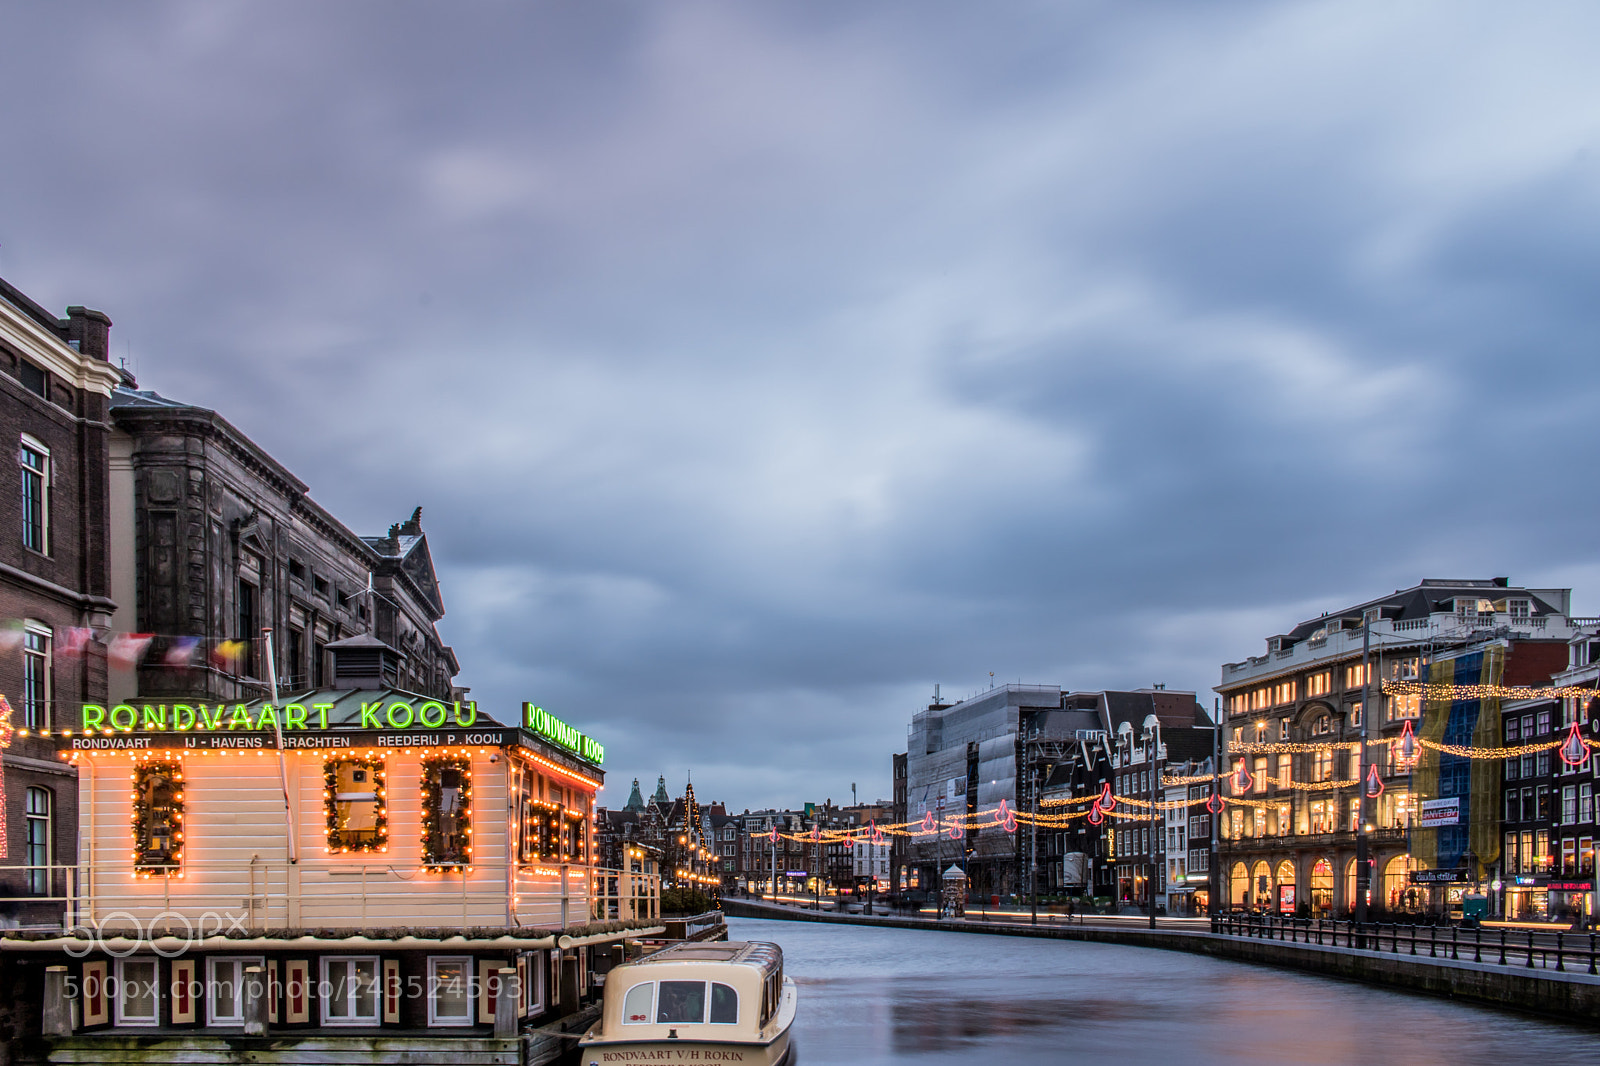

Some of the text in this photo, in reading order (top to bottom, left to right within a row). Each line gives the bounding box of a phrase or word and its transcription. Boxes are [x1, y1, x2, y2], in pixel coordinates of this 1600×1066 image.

[82, 704, 334, 730] RONDVAART
[528, 702, 581, 752] RONDVAART
[72, 738, 151, 749] RONDVAART
[211, 738, 263, 748] HAVENS
[281, 737, 350, 748] GRACHTEN
[378, 735, 439, 746] REEDERIJ
[465, 733, 503, 745] KOOIJ
[1107, 828, 1115, 857] HOTEL
[603, 1050, 743, 1061] RONDVAART V/H ROKIN
